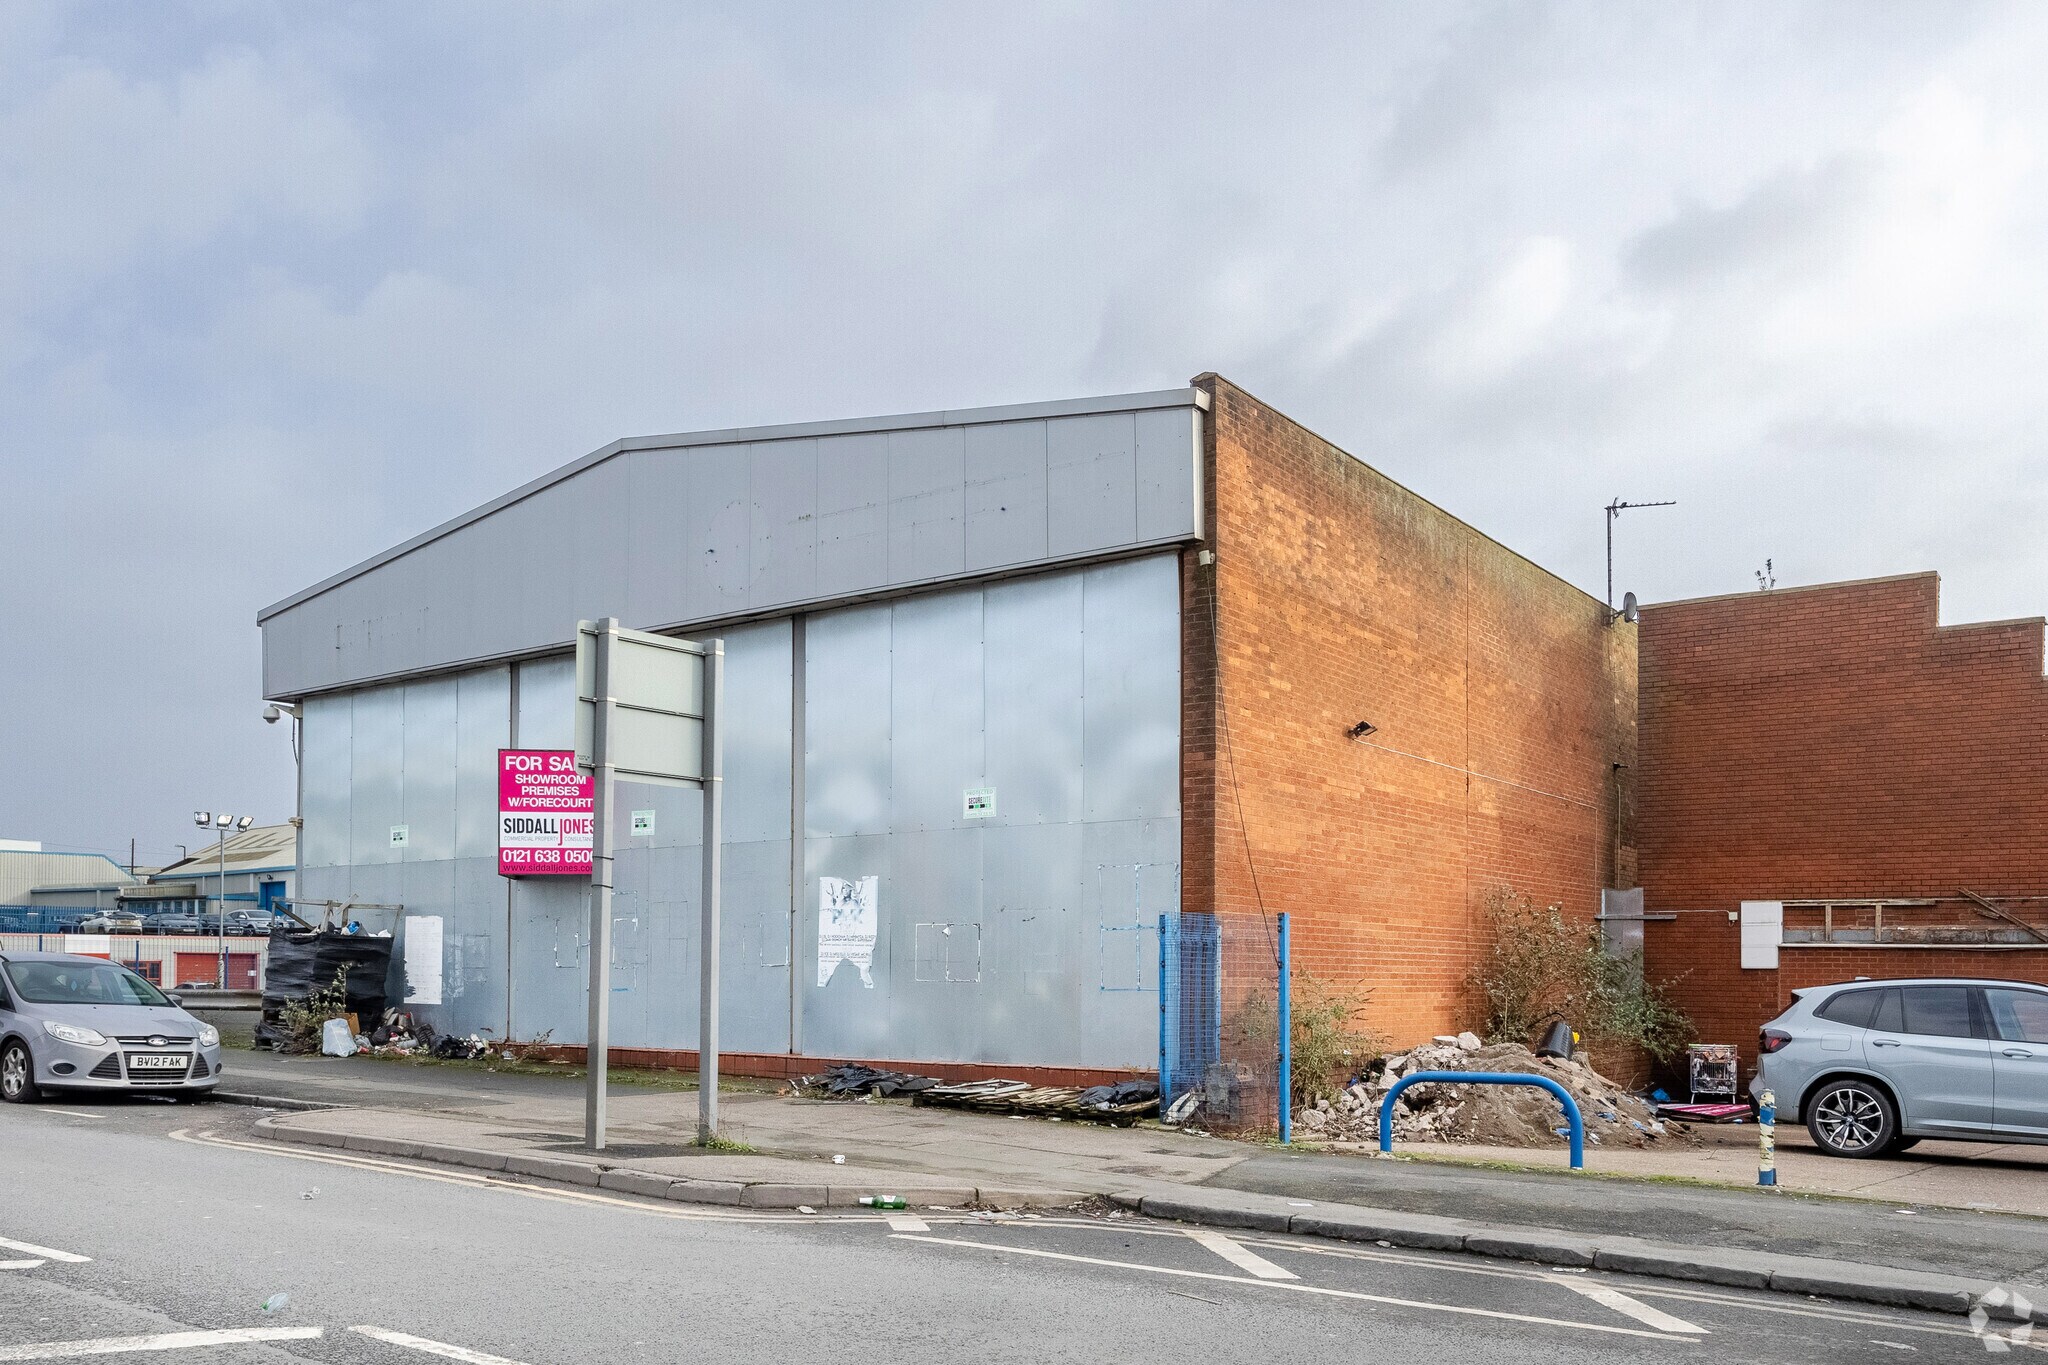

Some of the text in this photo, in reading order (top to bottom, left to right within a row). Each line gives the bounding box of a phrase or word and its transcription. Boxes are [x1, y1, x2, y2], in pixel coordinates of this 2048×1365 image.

[505, 755, 543, 771] FOR
[548, 756, 575, 771] SA
[515, 774, 587, 785] SHOWROOM
[521, 786, 580, 796] PREMISES
[508, 797, 594, 808] W/FORECOURT
[503, 818, 594, 846] SIDDALL JONES
[502, 849, 531, 863] 0121
[534, 849, 561, 863] 638
[503, 864, 593, 873] www.siddalljones.co
[137, 1057, 182, 1067] BV12 FAK
